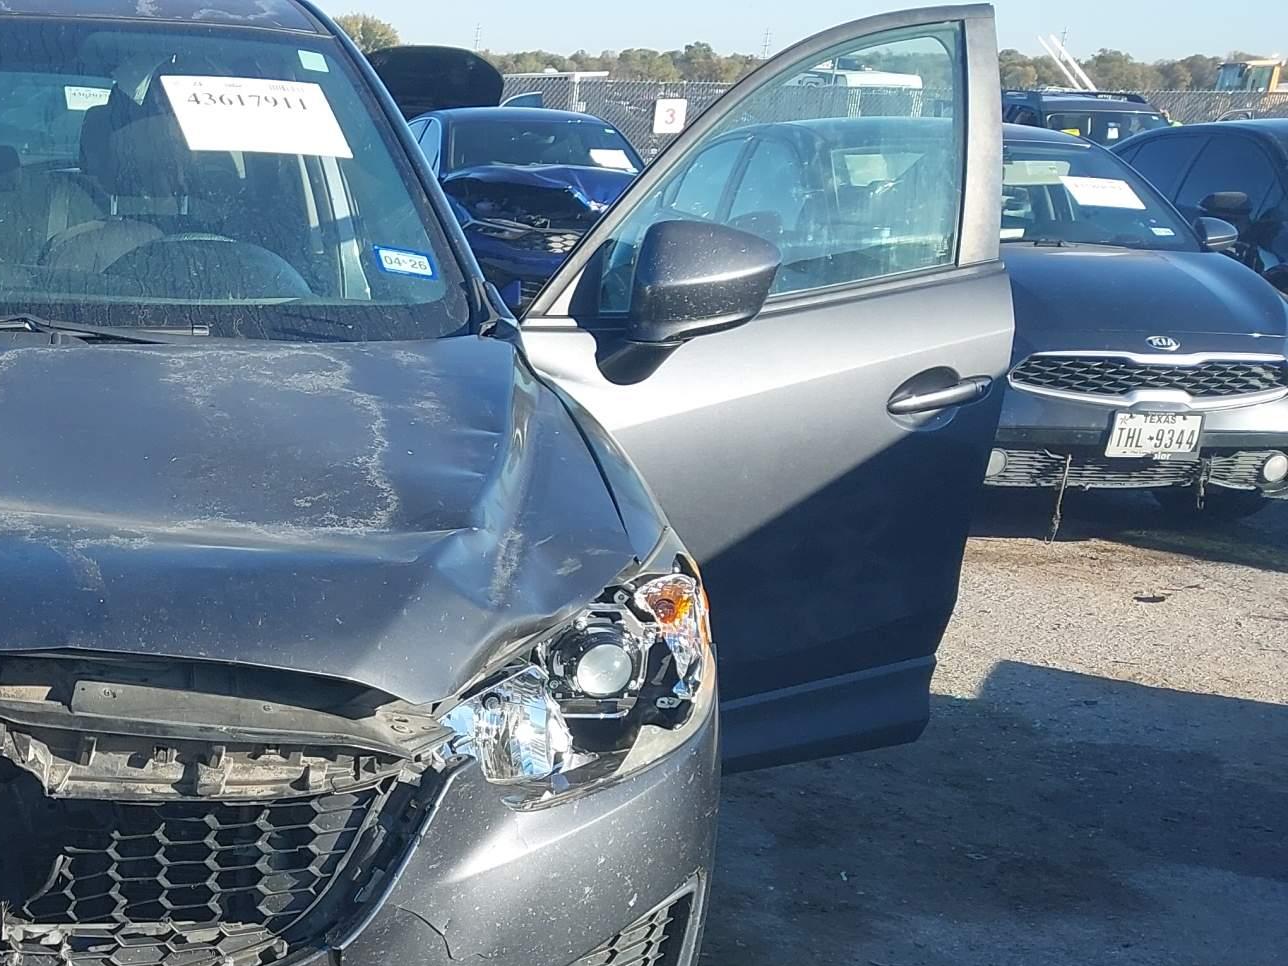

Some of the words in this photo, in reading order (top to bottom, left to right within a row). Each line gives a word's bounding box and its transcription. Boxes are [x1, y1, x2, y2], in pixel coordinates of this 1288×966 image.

[187, 92, 307, 111] 43617911
[664, 107, 677, 126] 3
[1143, 414, 1177, 424] TEXAS
